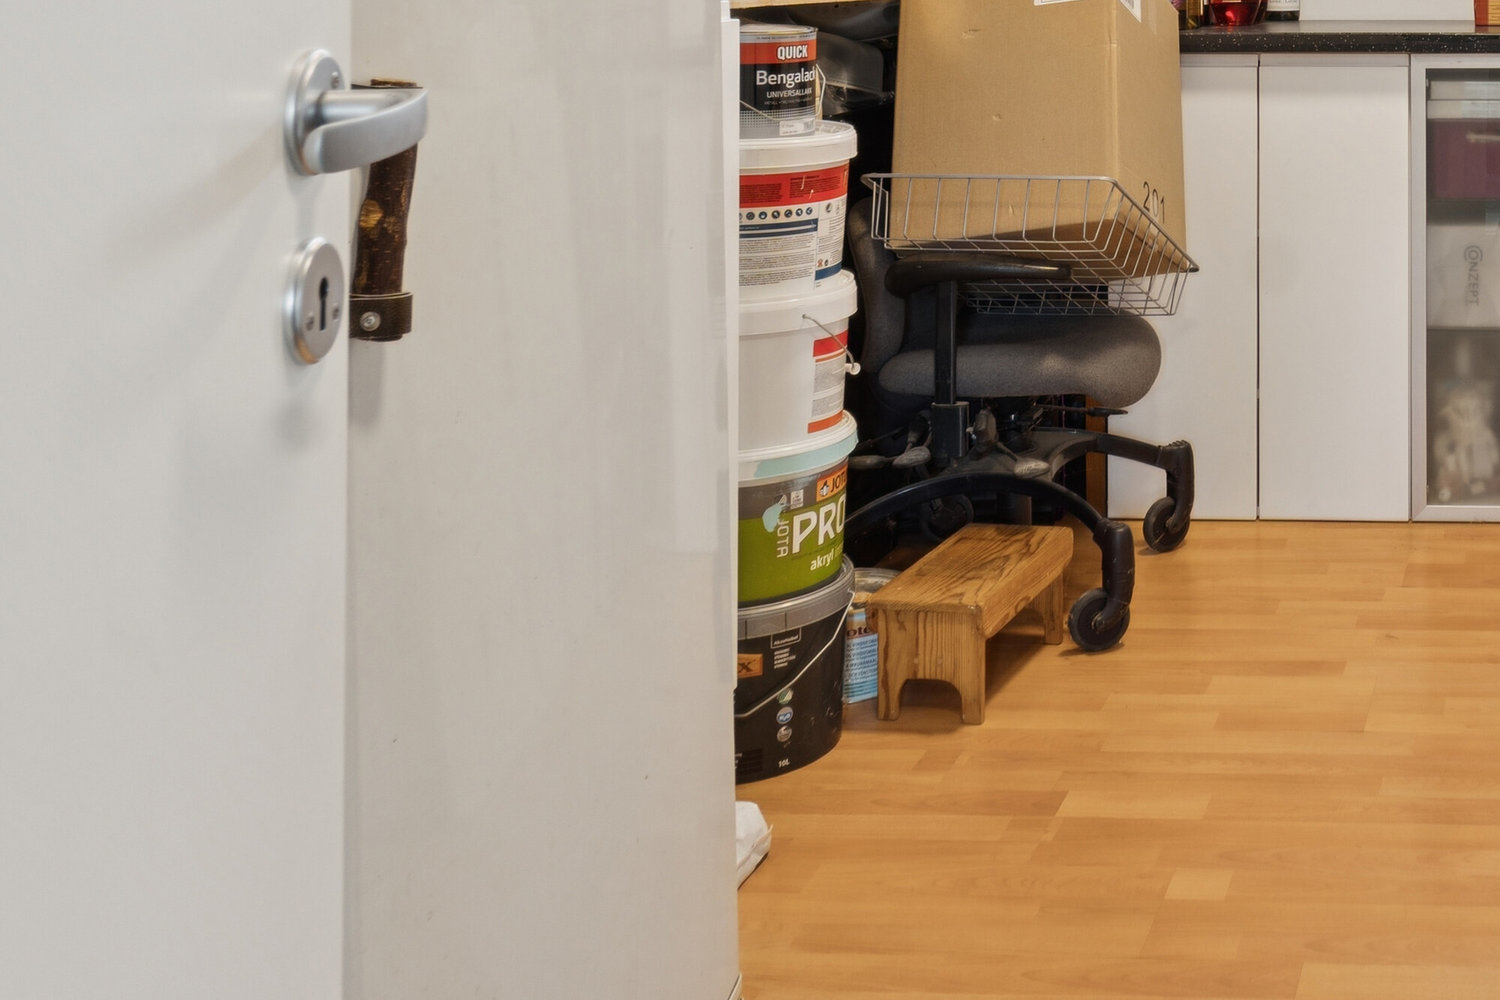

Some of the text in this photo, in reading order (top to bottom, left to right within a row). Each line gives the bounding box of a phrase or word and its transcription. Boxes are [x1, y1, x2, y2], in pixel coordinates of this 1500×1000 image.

[777, 45, 808, 60] QUICK
[792, 493, 847, 554] PRO
[810, 547, 835, 571] akryl
